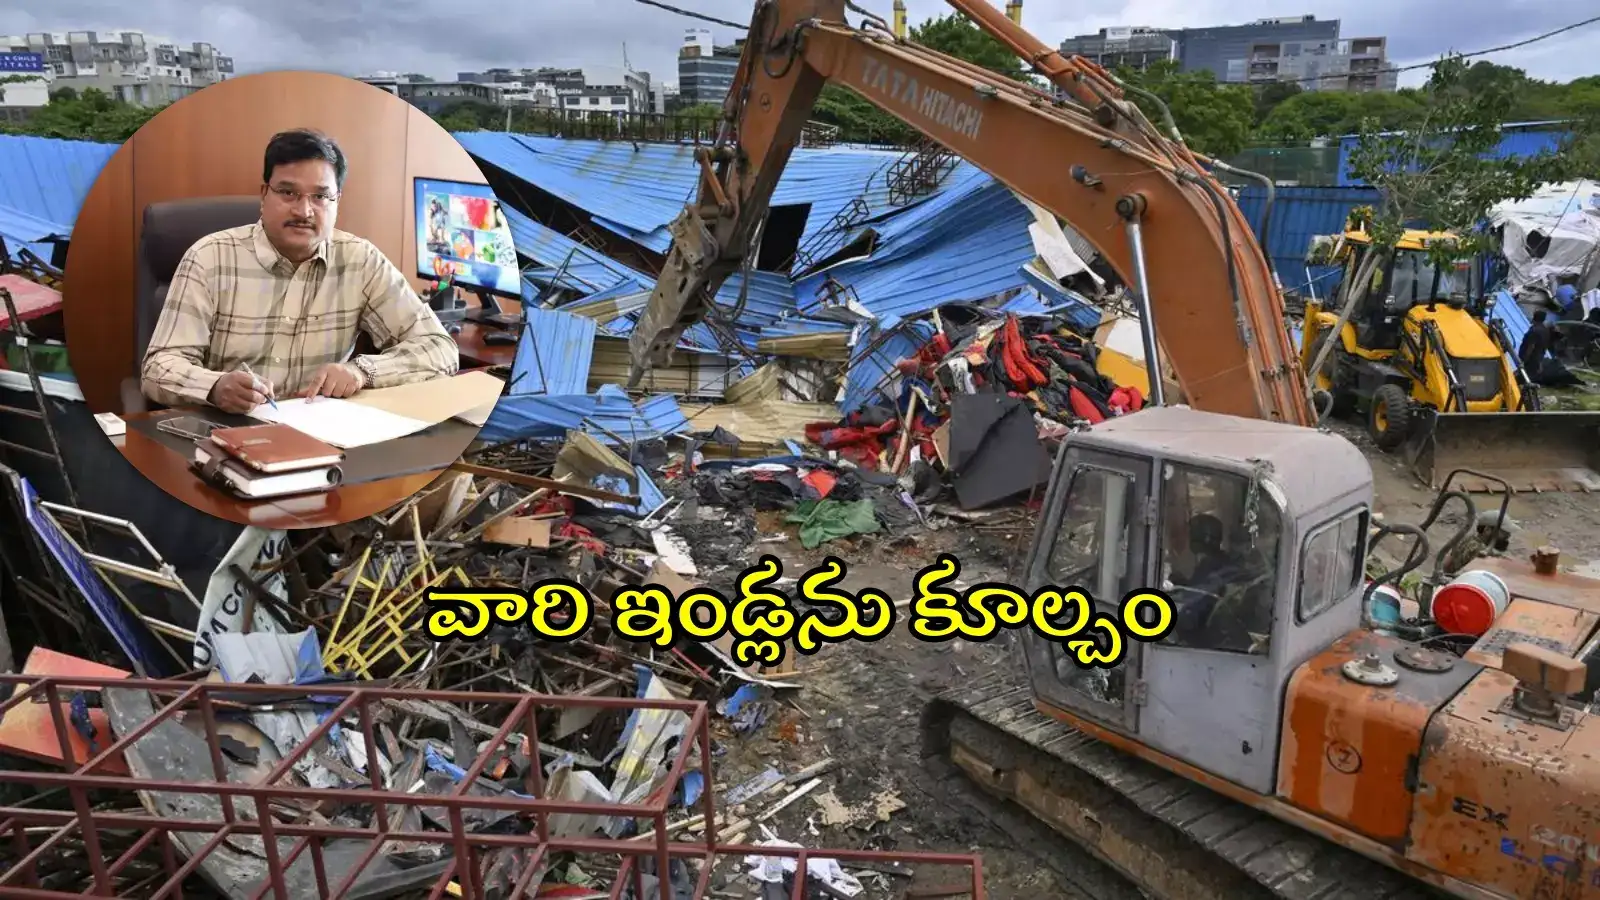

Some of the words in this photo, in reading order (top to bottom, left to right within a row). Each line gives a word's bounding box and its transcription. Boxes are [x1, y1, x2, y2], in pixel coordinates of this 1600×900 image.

[862, 56, 919, 111] TATA
[918, 85, 983, 141] HITACHI
[1452, 796, 1509, 832] EX
